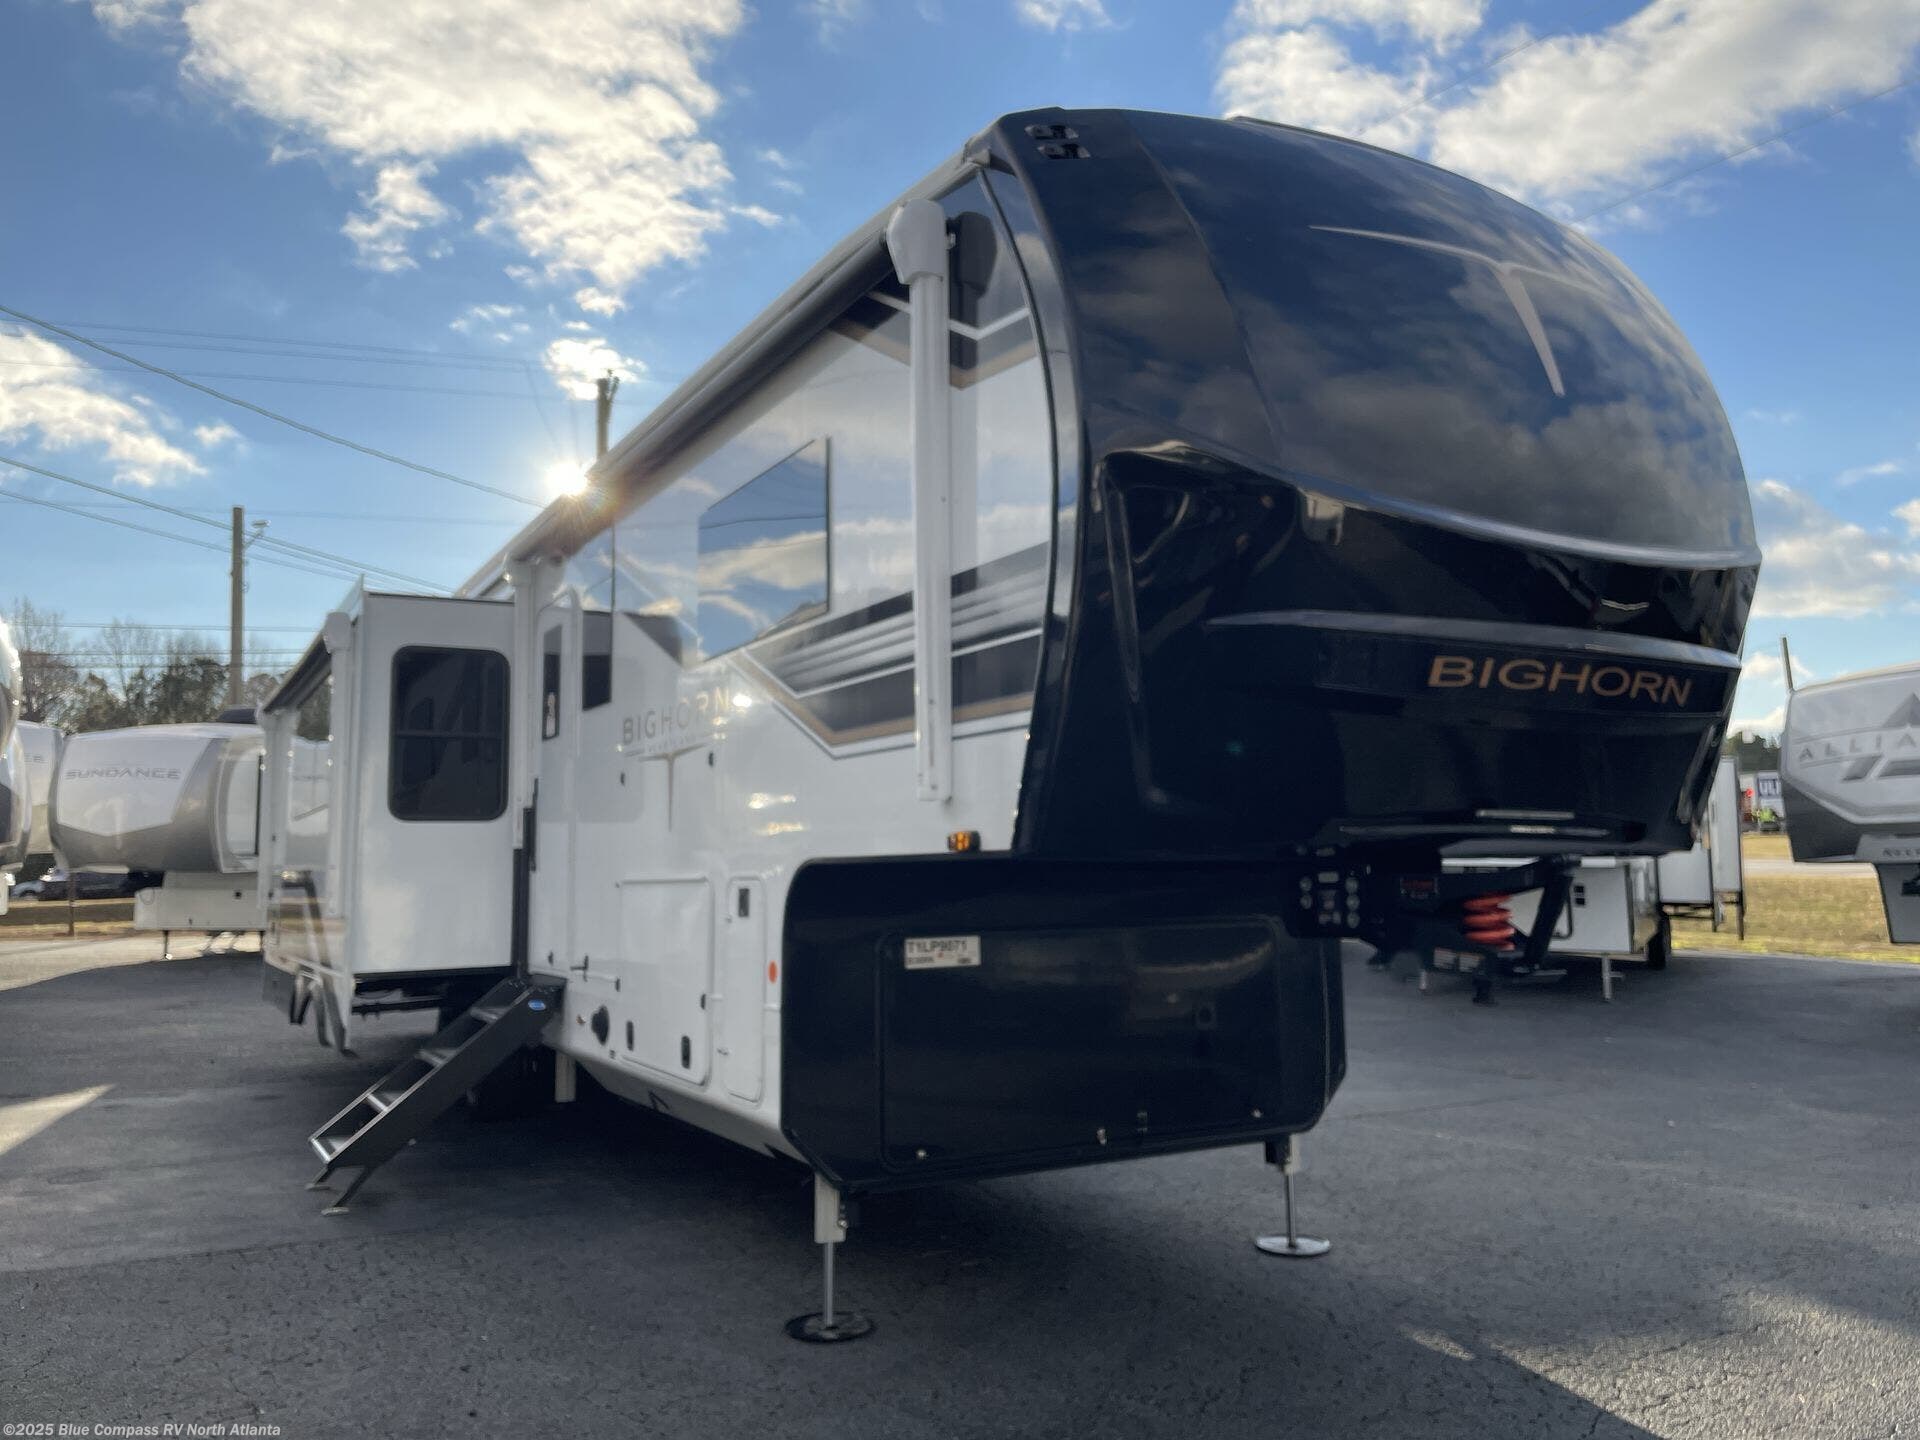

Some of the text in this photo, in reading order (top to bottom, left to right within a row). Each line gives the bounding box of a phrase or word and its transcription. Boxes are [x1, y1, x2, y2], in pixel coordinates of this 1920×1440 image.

[1427, 655, 1692, 707] BIGHORN
[622, 687, 730, 745] BIGHORN
[65, 767, 181, 781] SUNDANCE
